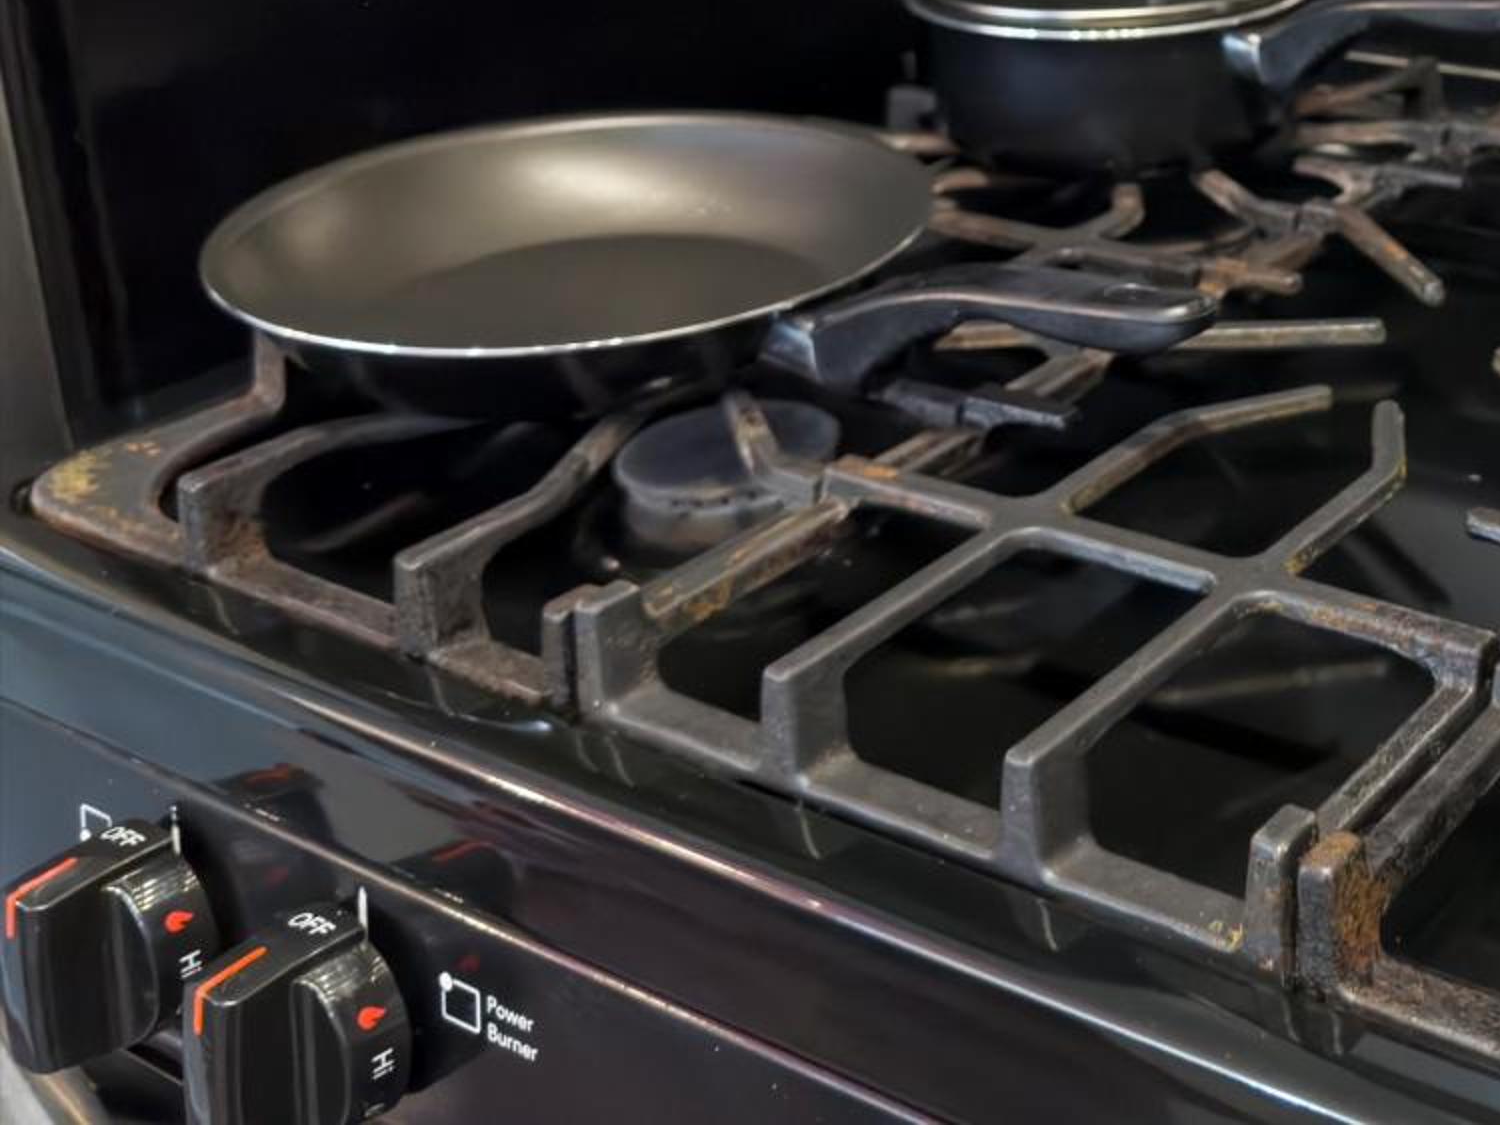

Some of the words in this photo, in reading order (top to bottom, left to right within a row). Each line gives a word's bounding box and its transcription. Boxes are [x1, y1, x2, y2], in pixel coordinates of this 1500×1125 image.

[100, 826, 146, 847] OFF
[287, 912, 337, 935] OFF
[486, 994, 535, 1033] Power
[486, 1022, 539, 1062] Burner
